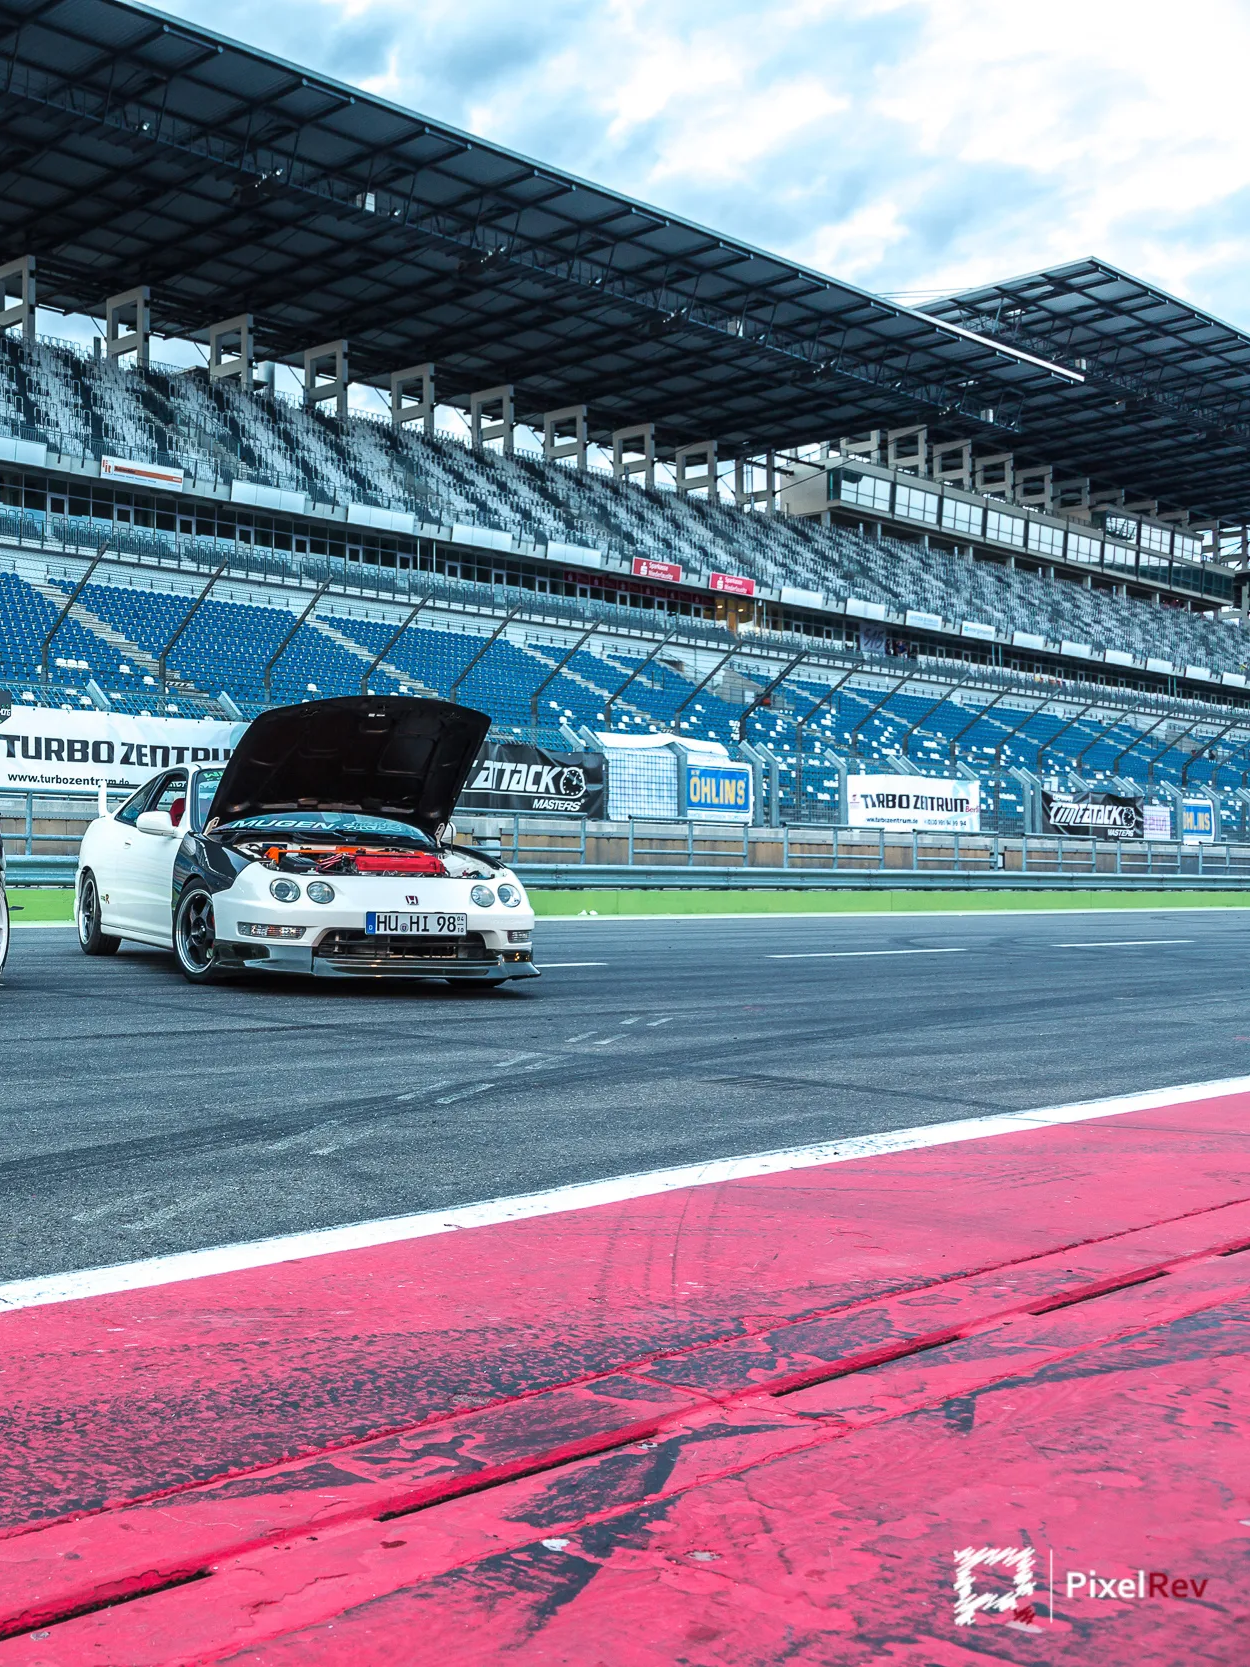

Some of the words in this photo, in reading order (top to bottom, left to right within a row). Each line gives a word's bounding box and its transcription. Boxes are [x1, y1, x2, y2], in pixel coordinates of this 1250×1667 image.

[120, 742, 235, 768] ZENTRU
[471, 760, 562, 794] ATTACK
[690, 770, 746, 806] ÖHLINS
[532, 799, 581, 812] MASTERS
[233, 820, 337, 830] MUGEN
[377, 914, 399, 932] HU
[410, 915, 429, 932] HI
[437, 916, 456, 933] 98
